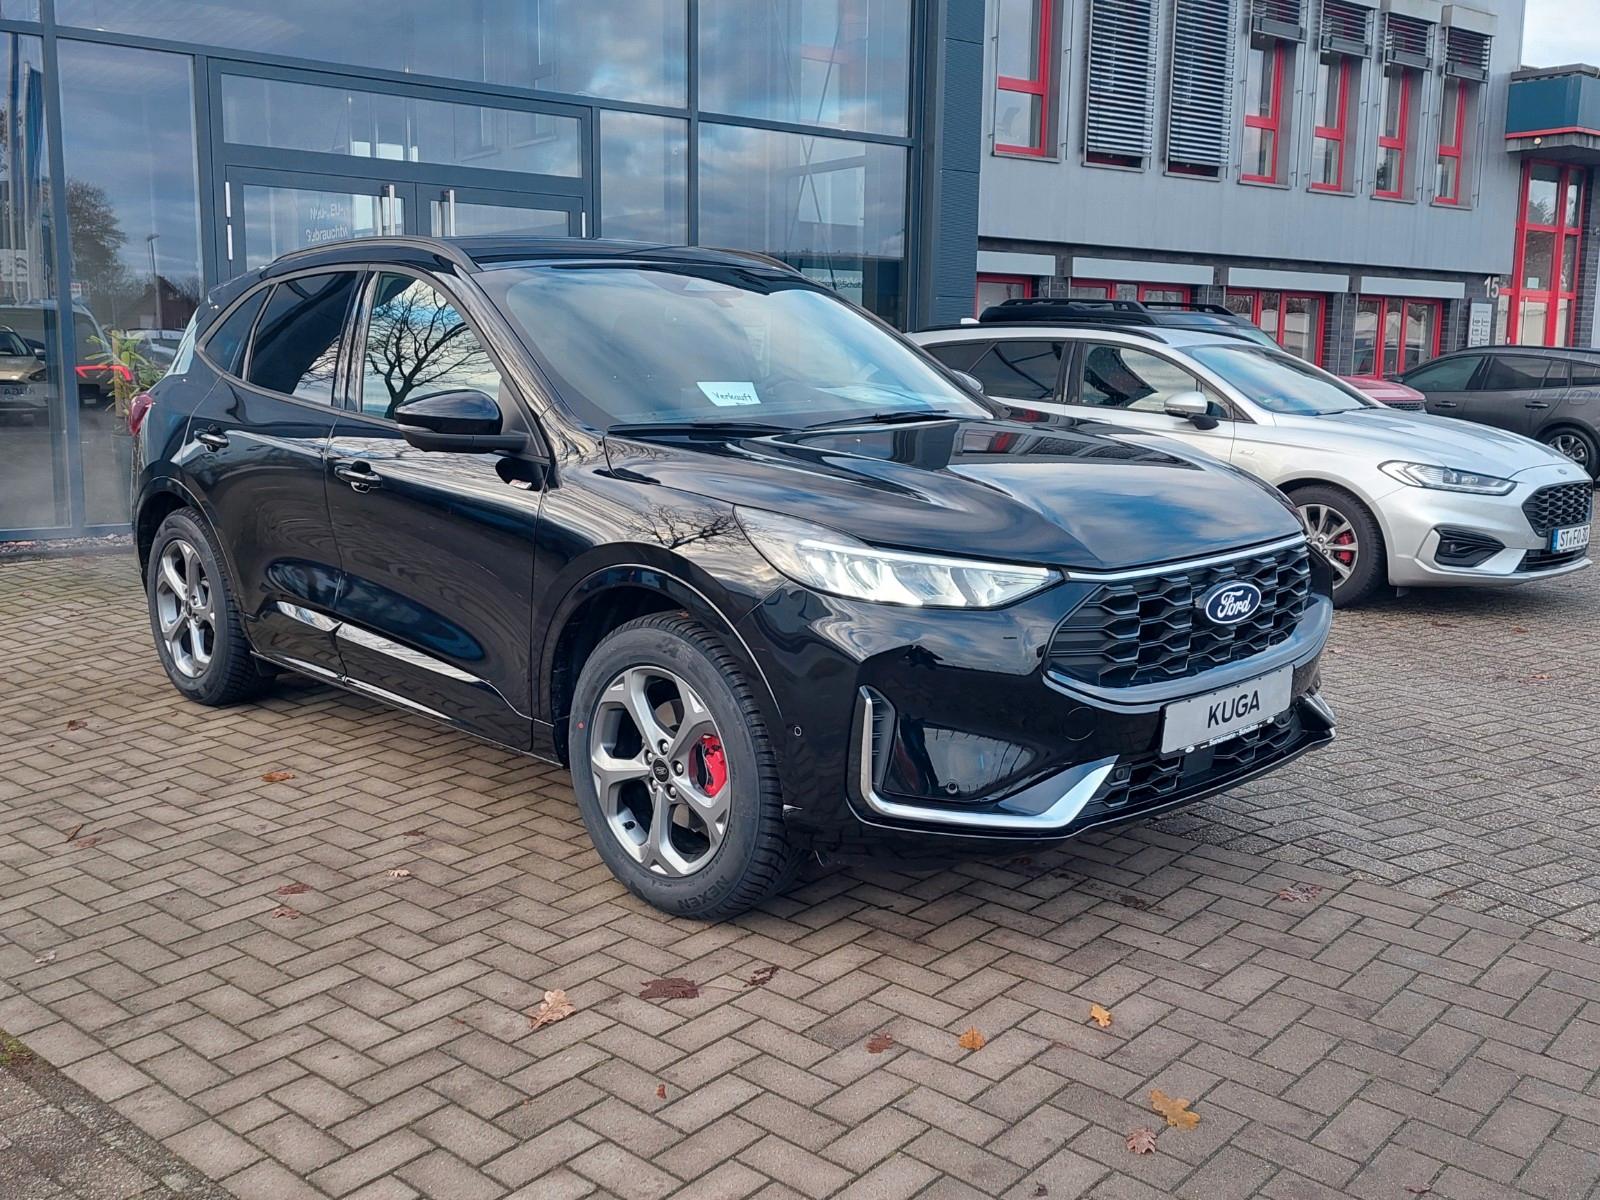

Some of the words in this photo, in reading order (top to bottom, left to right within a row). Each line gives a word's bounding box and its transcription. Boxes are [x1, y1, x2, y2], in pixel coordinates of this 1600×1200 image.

[1484, 275, 1500, 298] 15
[1217, 589, 1252, 618] Ford
[1207, 690, 1260, 728] KUGA
